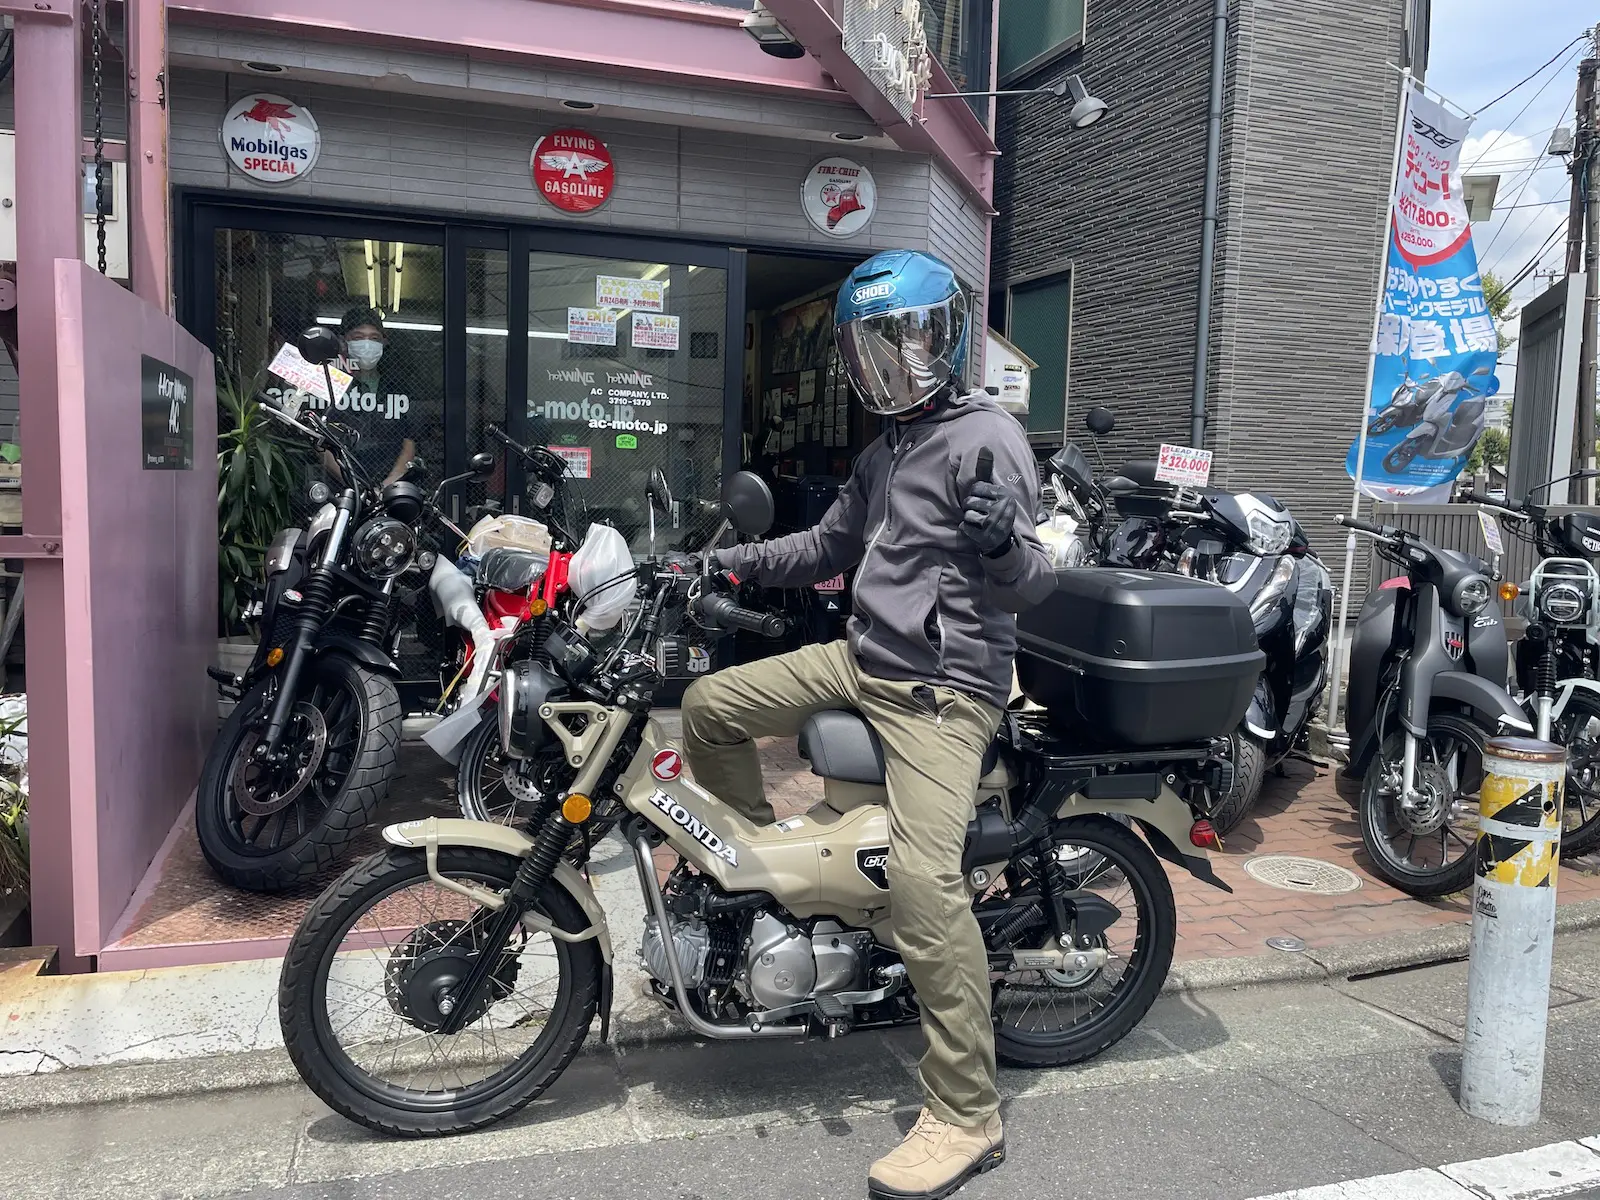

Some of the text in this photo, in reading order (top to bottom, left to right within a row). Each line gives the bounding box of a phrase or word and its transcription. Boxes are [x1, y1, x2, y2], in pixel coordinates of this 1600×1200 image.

[231, 137, 308, 160] Mobilgas
[554, 135, 596, 151] FLYING
[244, 157, 297, 175] SPECIAL
[817, 165, 861, 178] FIRE-CHIEF
[544, 180, 605, 199] GASOLINE
[856, 284, 889, 302] SHOEI
[590, 388, 669, 400] AC COMPANY, LTD.
[609, 396, 651, 406] 3710-1379
[169, 399, 180, 434] AC
[588, 419, 668, 434] ac-moto.jp
[1171, 447, 1192, 455] LEAD
[1473, 618, 1499, 628] Cub
[649, 786, 739, 867] HONDA
